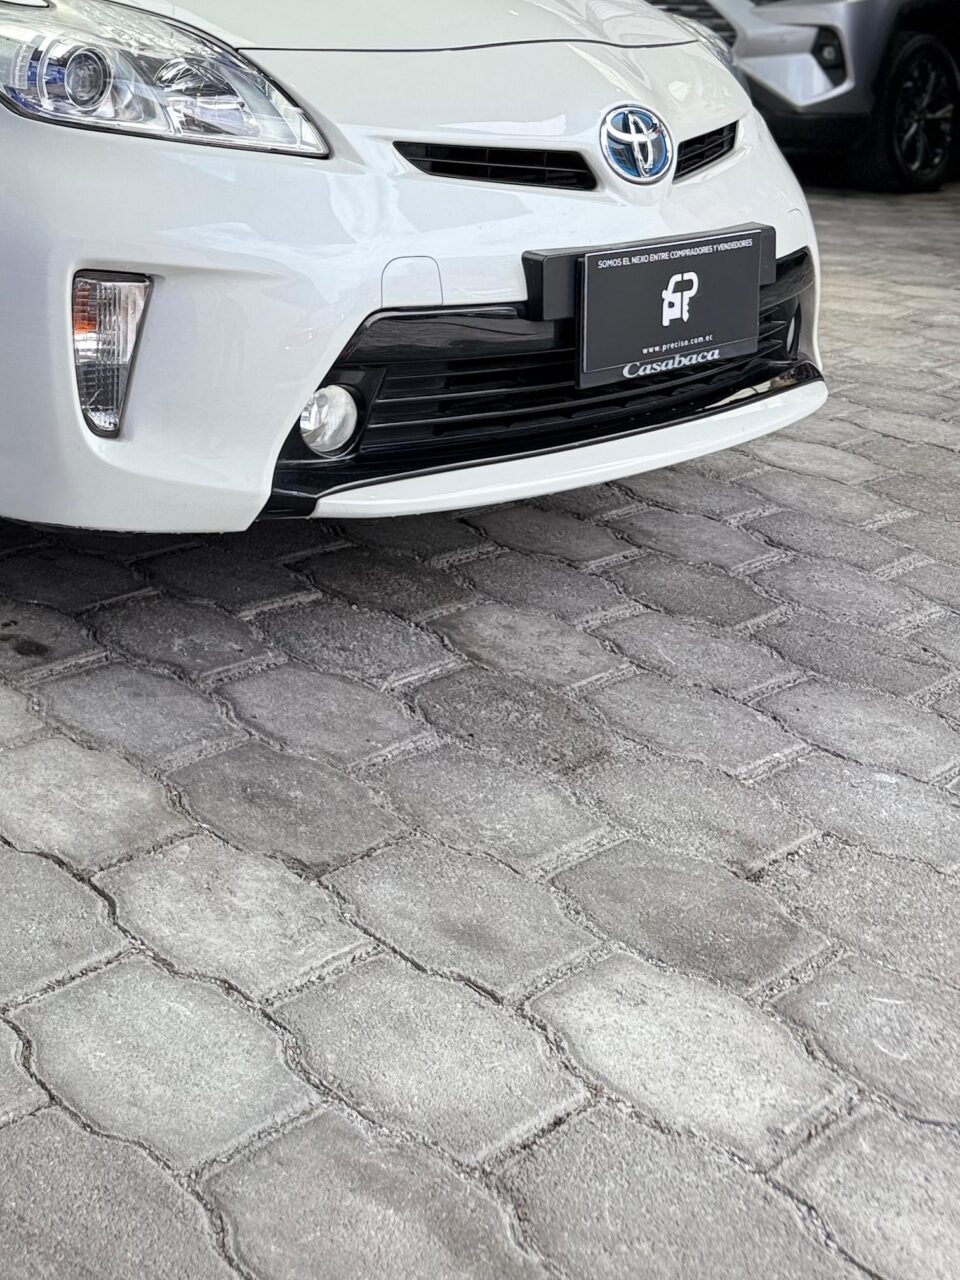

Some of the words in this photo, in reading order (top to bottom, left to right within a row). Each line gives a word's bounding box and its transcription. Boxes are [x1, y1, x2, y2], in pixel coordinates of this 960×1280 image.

[597, 257, 622, 269] SOMOS
[622, 257, 631, 266] EL
[631, 254, 649, 265] NEXO
[649, 251, 670, 262] ENTRE
[669, 246, 713, 259] COMPRADORES
[717, 238, 753, 252] VENDEDORES
[642, 334, 713, 354] www.preciso.com.ec
[622, 348, 720, 379] Casabaca
